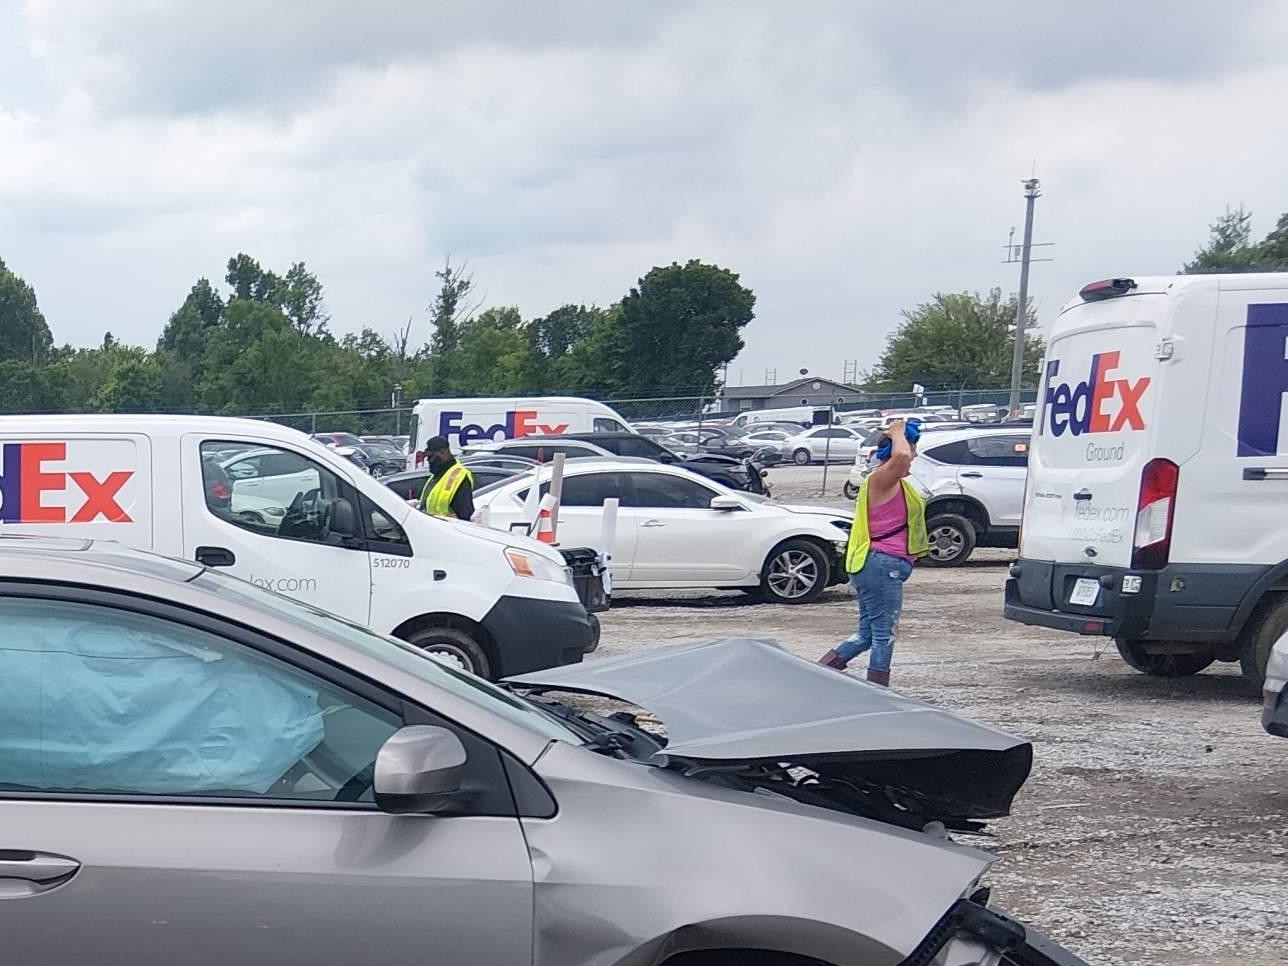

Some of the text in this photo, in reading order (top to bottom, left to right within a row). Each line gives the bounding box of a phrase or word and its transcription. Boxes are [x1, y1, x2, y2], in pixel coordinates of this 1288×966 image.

[1039, 351, 1151, 437] FedEx
[1086, 442, 1124, 462] Ground
[373, 558, 410, 569] 512070
